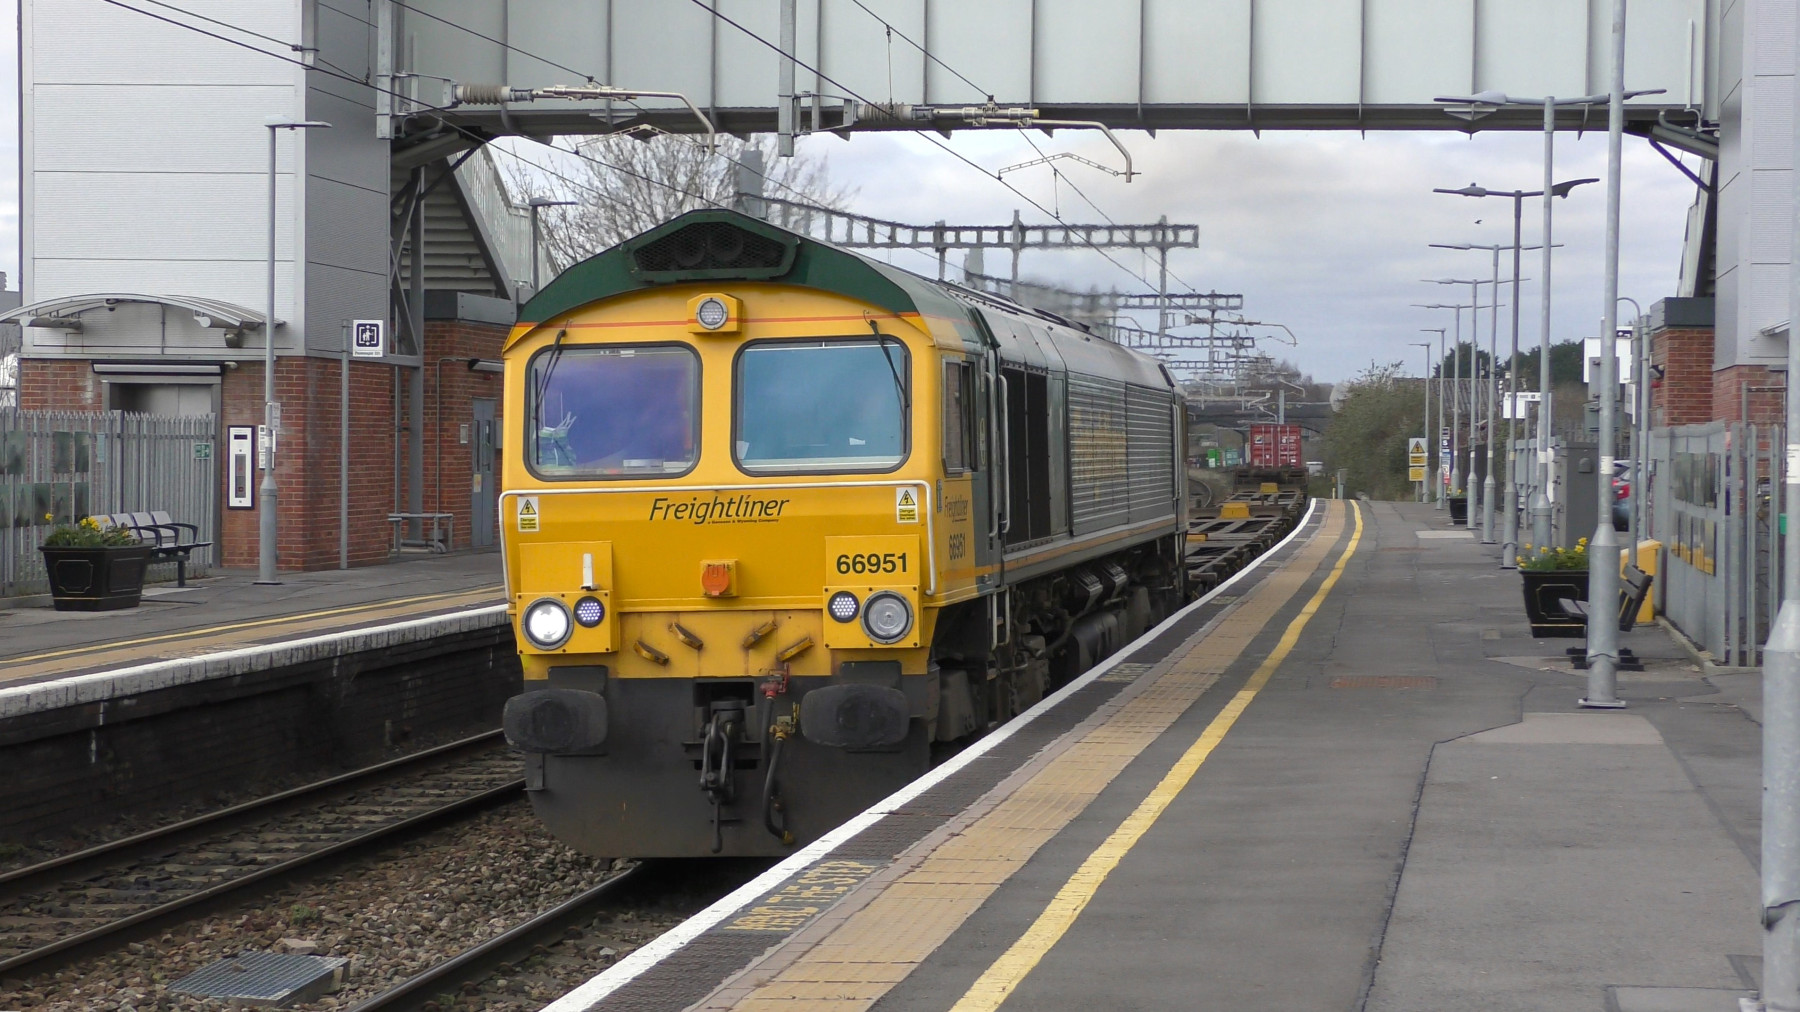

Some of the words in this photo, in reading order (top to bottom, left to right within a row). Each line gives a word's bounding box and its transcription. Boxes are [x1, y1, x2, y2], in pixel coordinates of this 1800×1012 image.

[649, 495, 790, 524] Freightliner
[949, 532, 966, 560] 66951
[836, 552, 908, 575] 66951
[797, 860, 878, 885] STEP
[765, 885, 849, 903] THE
[723, 905, 819, 931] MIND
